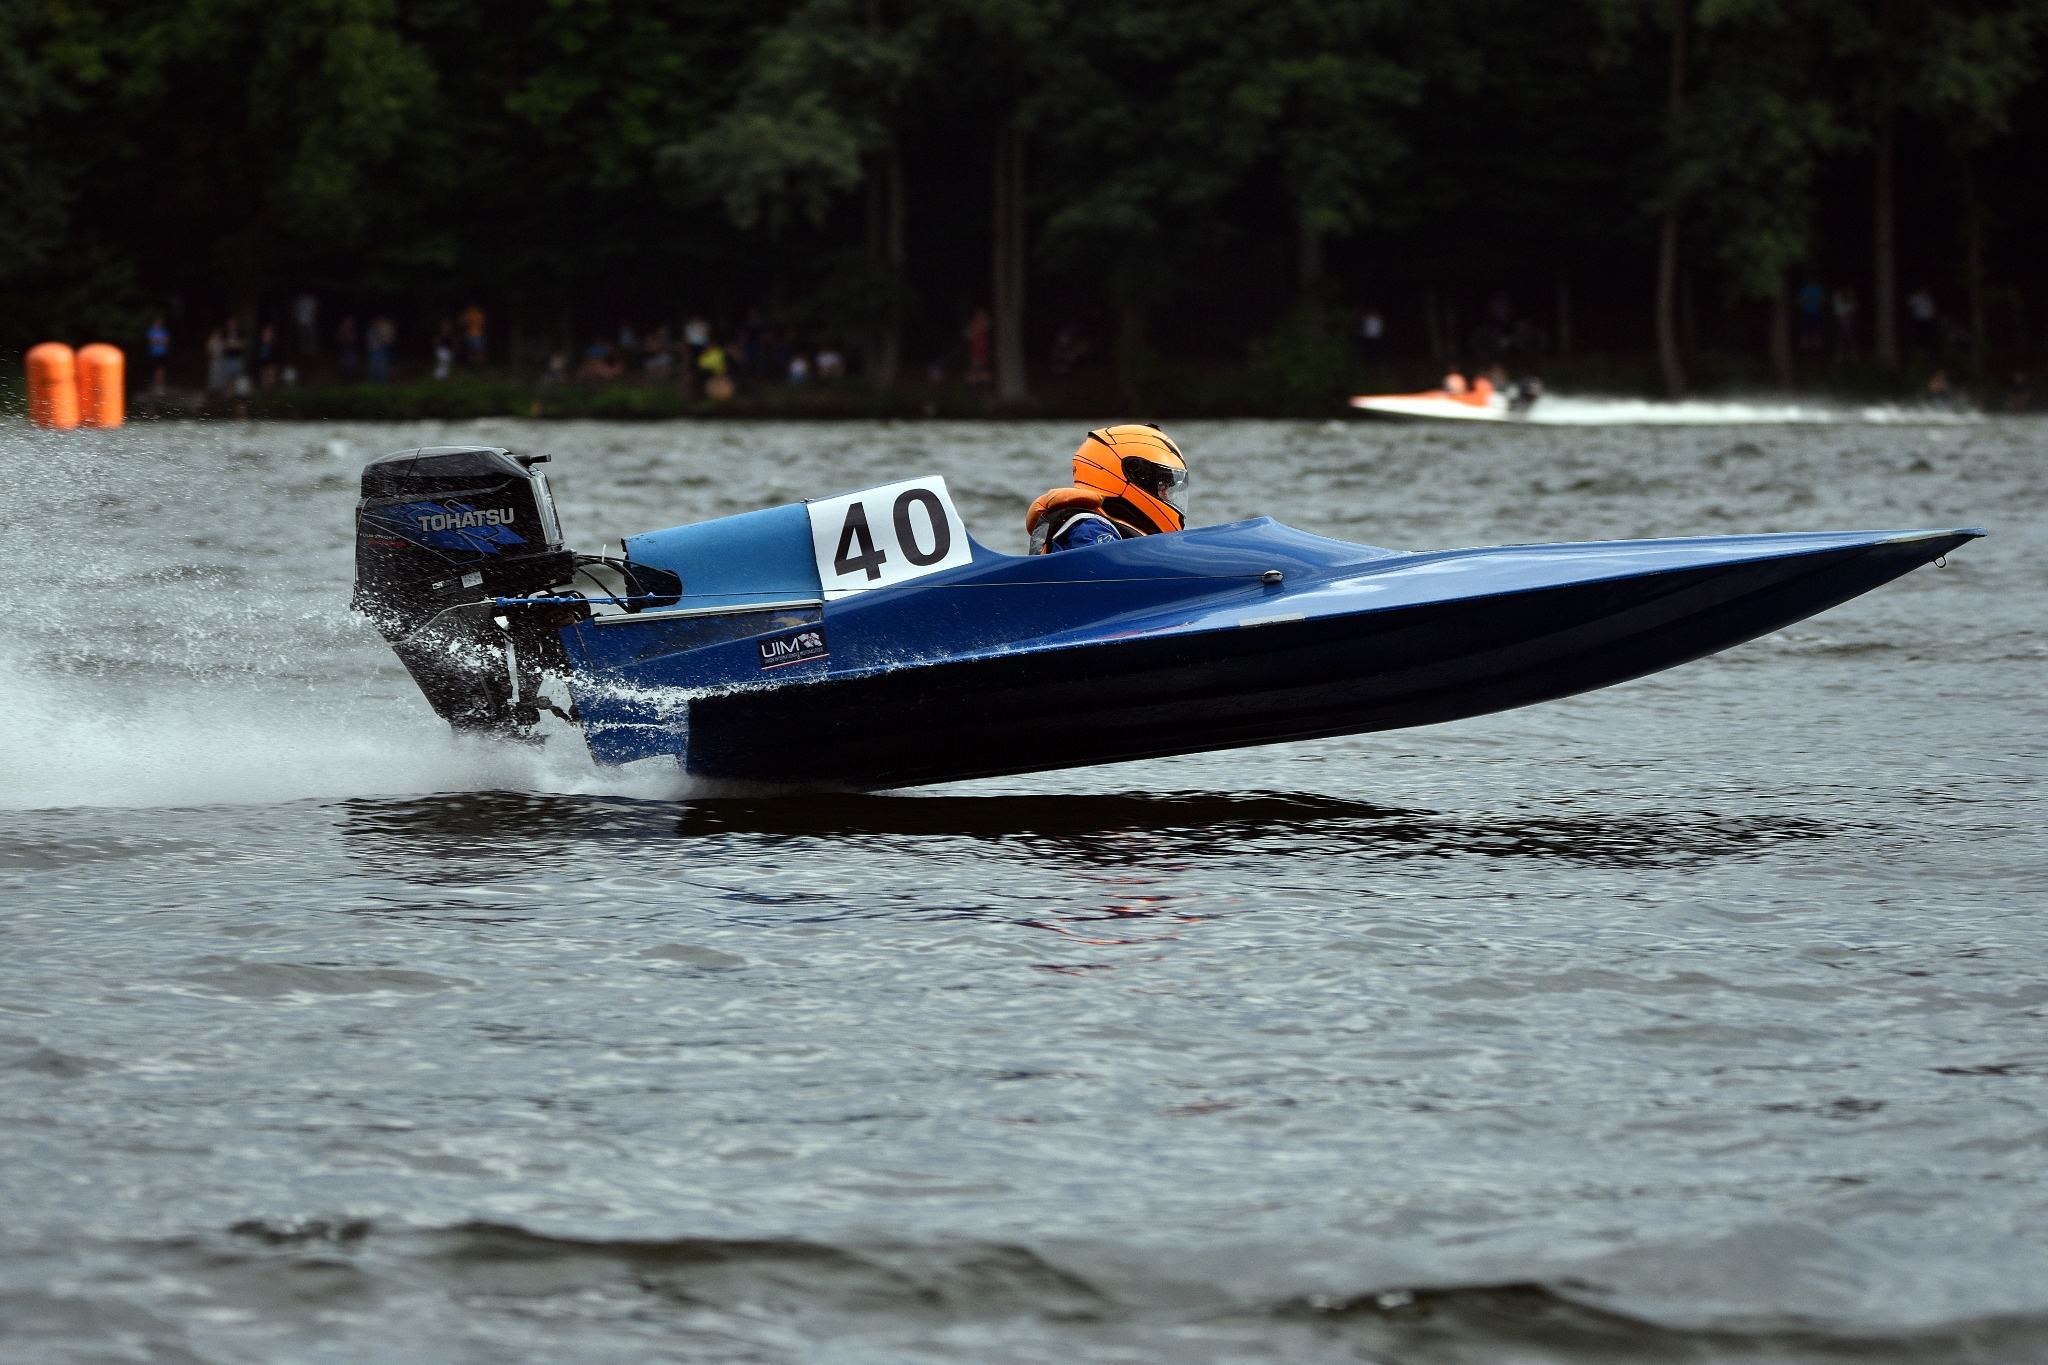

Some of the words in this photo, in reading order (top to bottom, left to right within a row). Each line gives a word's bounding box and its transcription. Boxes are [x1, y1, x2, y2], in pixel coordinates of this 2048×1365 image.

[418, 508, 515, 532] TOHATSU
[834, 488, 951, 582] 40
[761, 638, 800, 658] UIM
